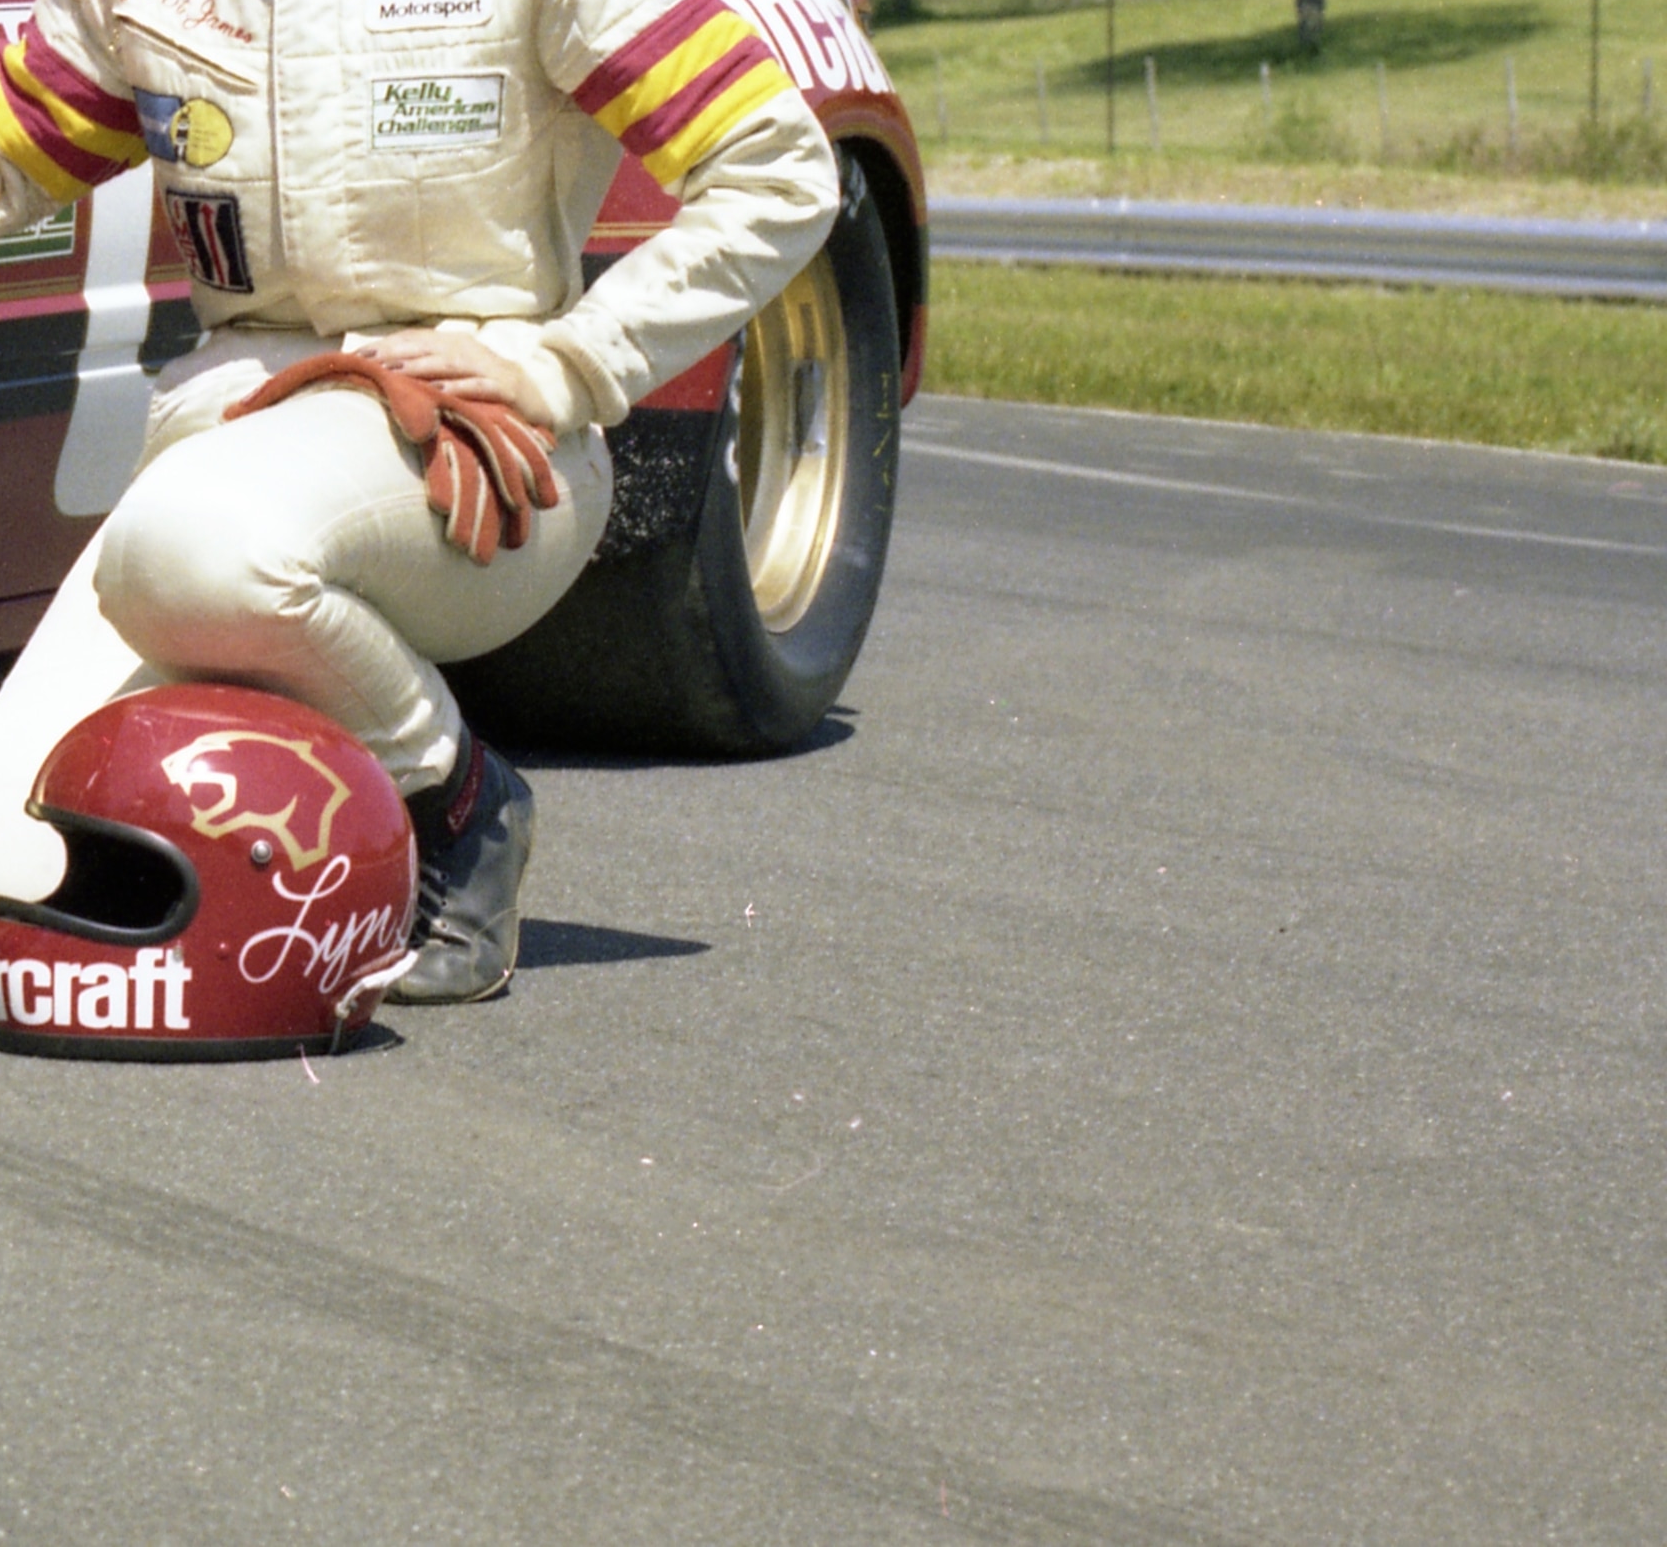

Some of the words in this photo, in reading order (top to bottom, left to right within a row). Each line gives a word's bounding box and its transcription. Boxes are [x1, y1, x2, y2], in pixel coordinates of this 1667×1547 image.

[383, 81, 452, 103] Kelly
[394, 98, 496, 116] American
[377, 118, 481, 134] Challenge
